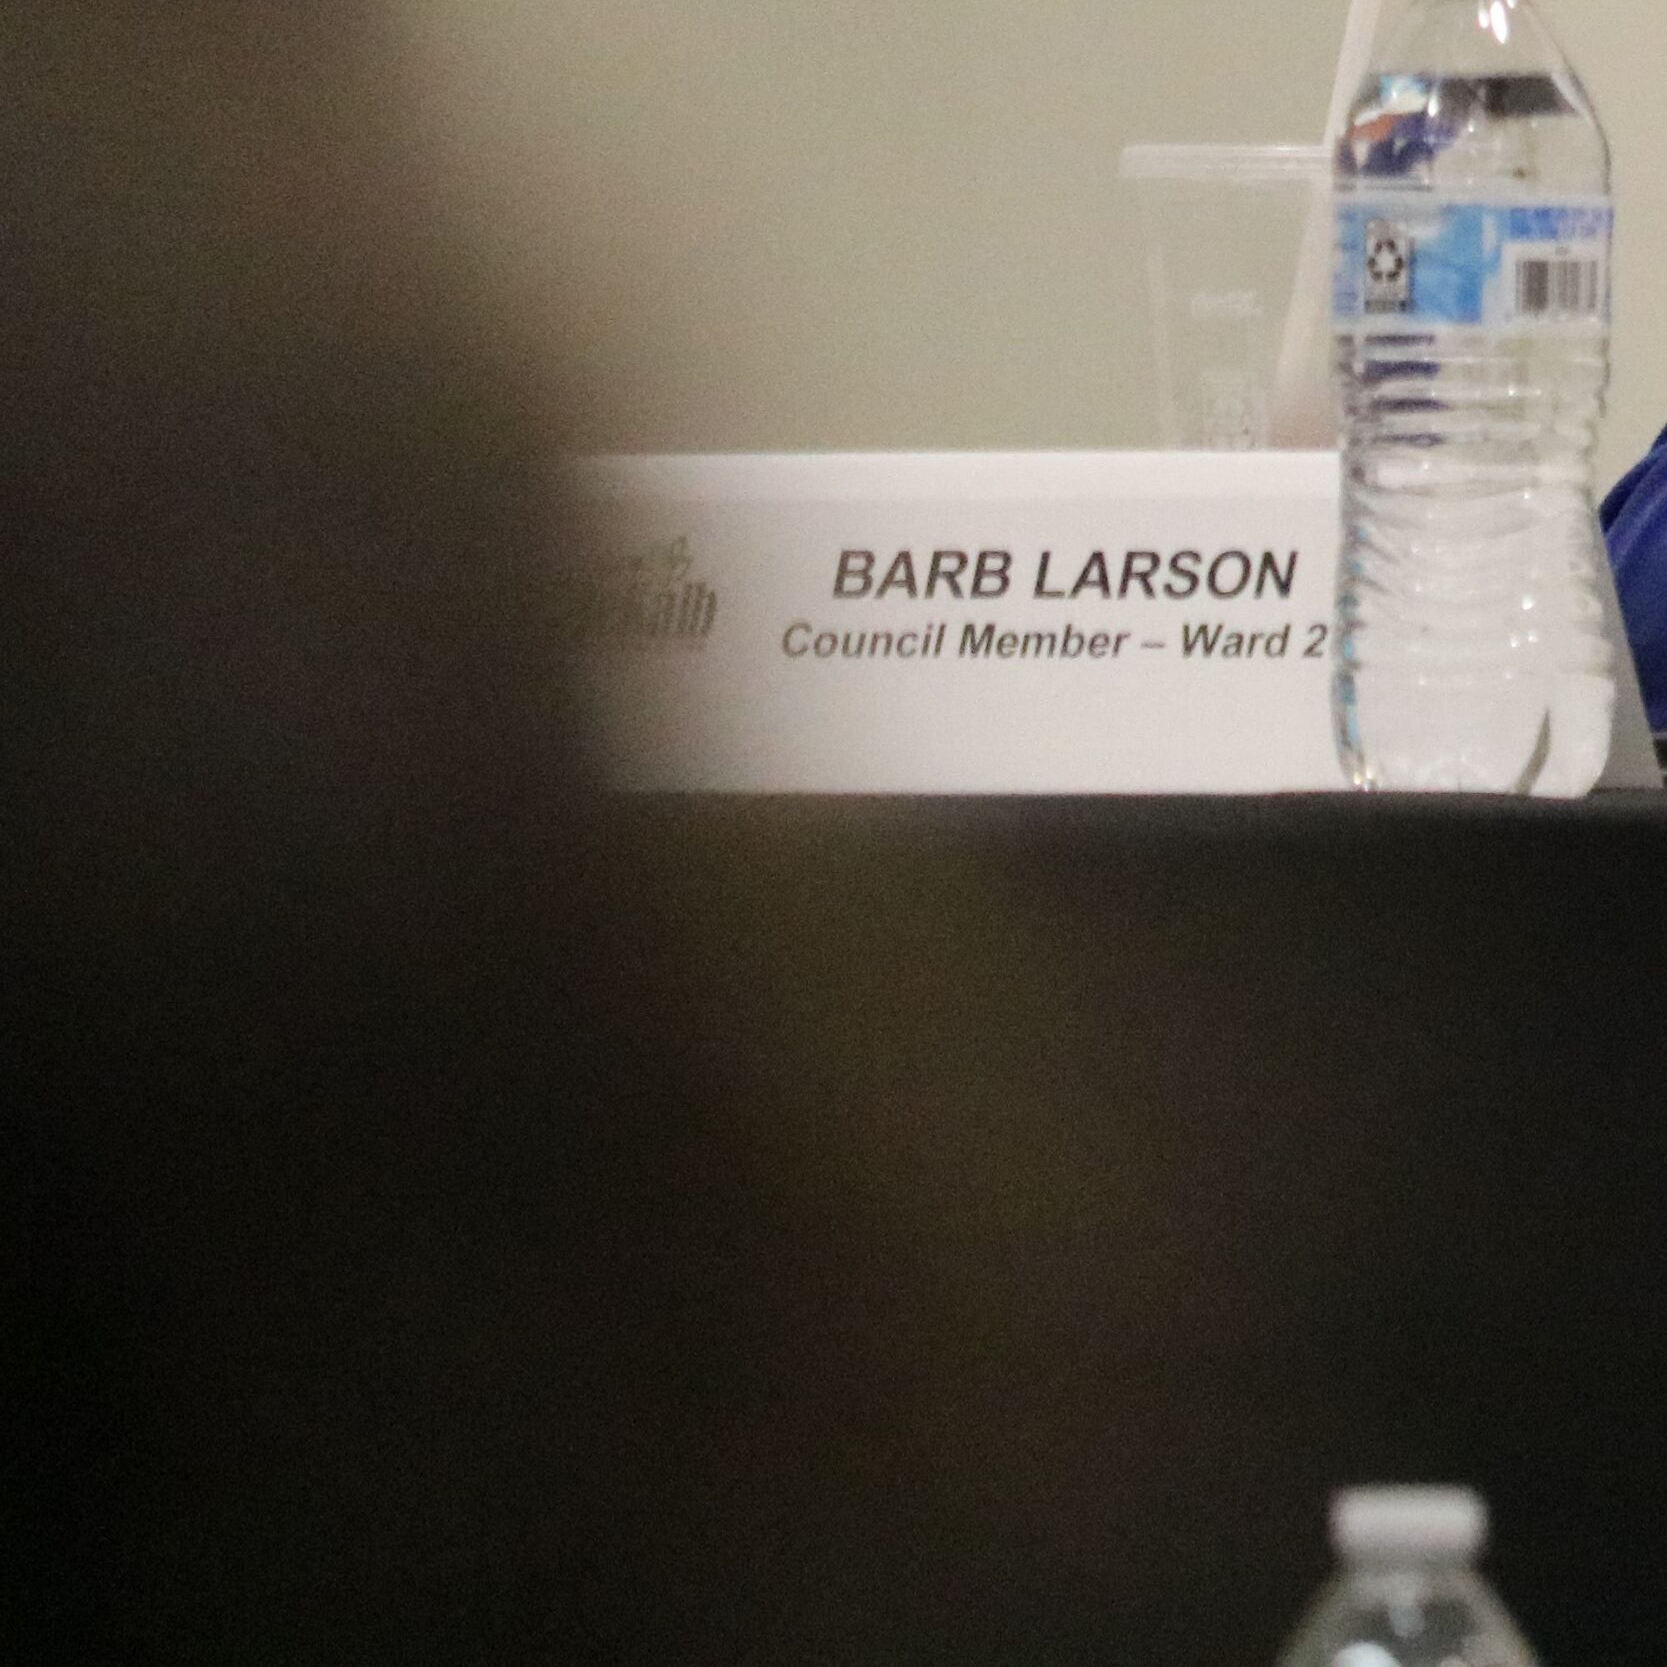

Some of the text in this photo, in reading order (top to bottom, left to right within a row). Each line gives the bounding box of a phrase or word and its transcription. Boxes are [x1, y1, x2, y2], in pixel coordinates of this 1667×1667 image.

[832, 549, 1300, 600] BARB LARSON
[781, 622, 947, 659] Council
[958, 622, 1131, 659] Member
[1181, 622, 1292, 659] Ward
[1303, 622, 1328, 659] 2
